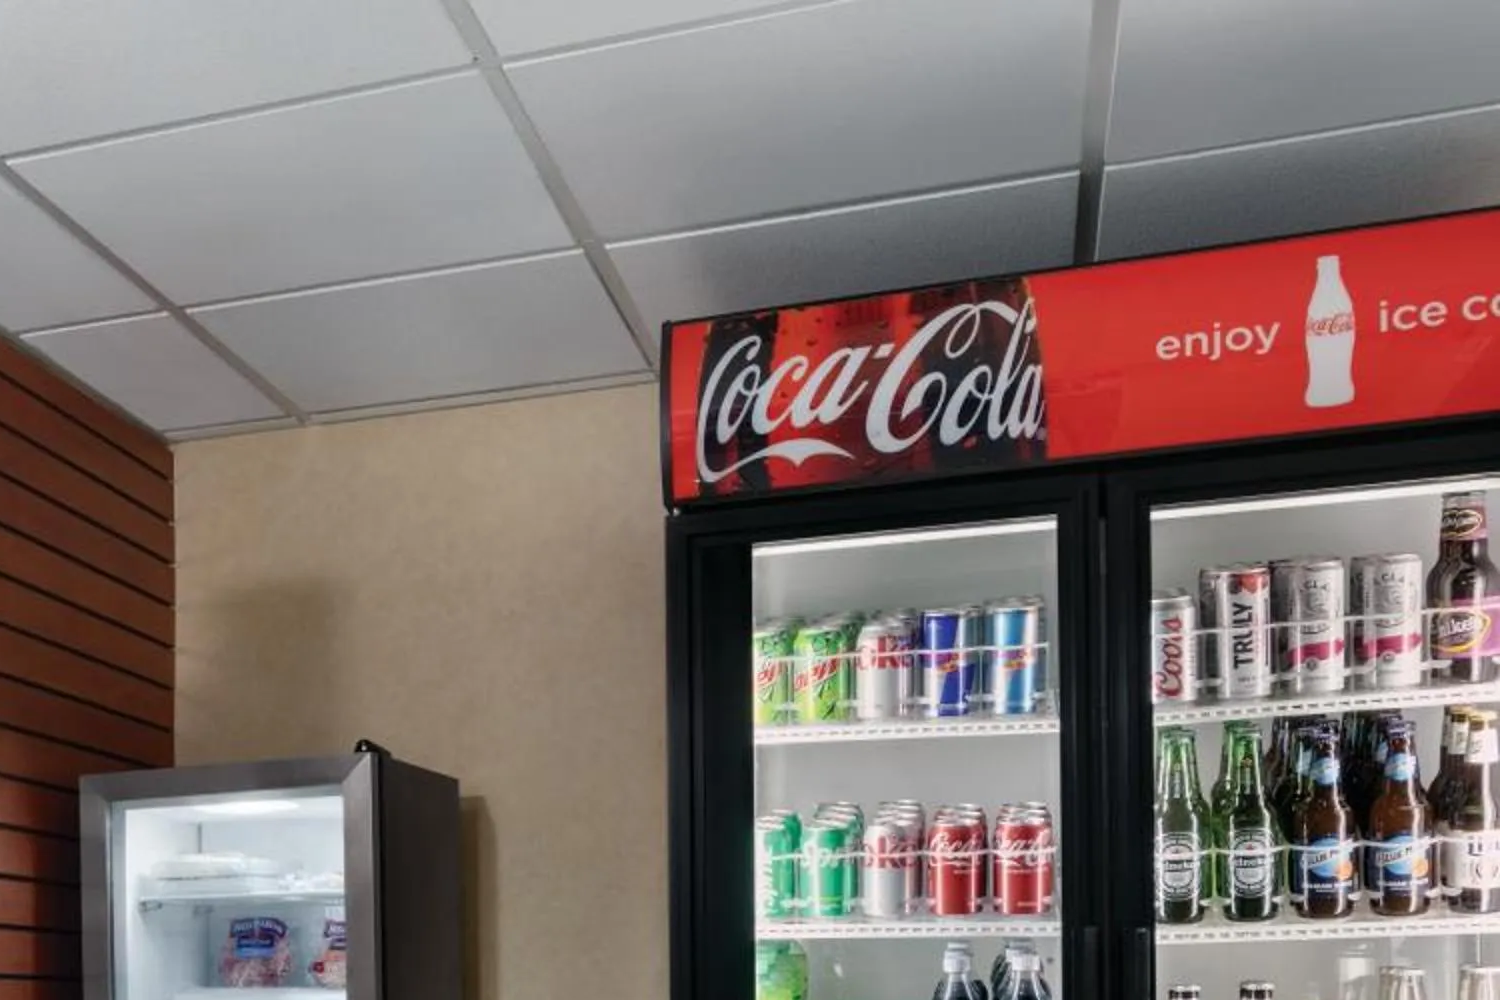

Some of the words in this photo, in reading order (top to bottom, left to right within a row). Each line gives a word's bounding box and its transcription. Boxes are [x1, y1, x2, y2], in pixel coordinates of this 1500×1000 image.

[1155, 320, 1280, 361] enjoy
[1378, 300, 1448, 333] ice
[696, 298, 1045, 482] Coca-Cola
[1155, 614, 1183, 697] Coors
[1232, 602, 1255, 669] TRULY
